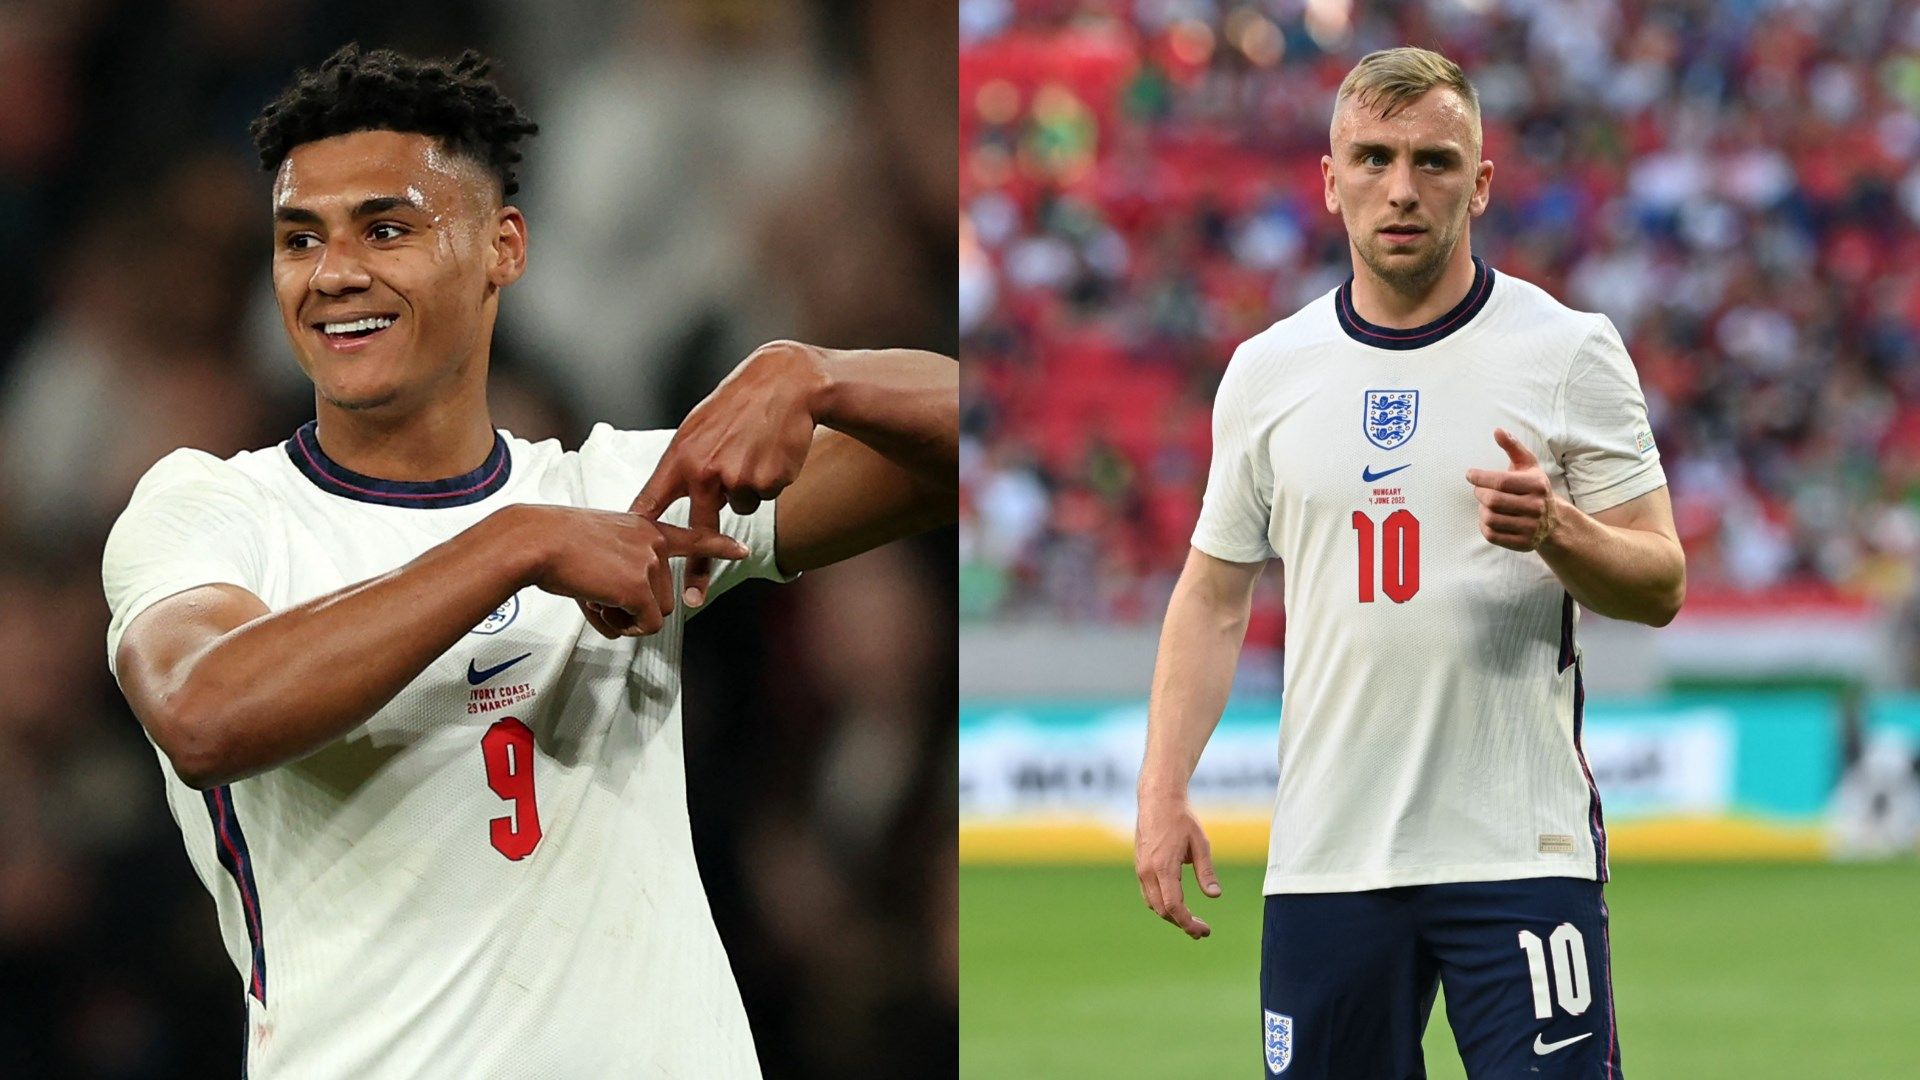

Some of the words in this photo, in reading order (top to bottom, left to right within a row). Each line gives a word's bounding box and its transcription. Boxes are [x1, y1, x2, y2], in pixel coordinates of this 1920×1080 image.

[1368, 497, 1373, 505] 4
[1374, 497, 1390, 505] JUNE
[1391, 496, 1406, 504] 2022
[1372, 488, 1402, 496] HUNGARY
[1352, 509, 1420, 604] 10
[467, 702, 478, 714] 29
[480, 697, 514, 713] MARCH
[516, 688, 536, 702] 2022
[470, 688, 496, 700] IVORY
[500, 683, 529, 697] COAST
[480, 716, 543, 862] 9
[1518, 922, 1592, 1020] 10
